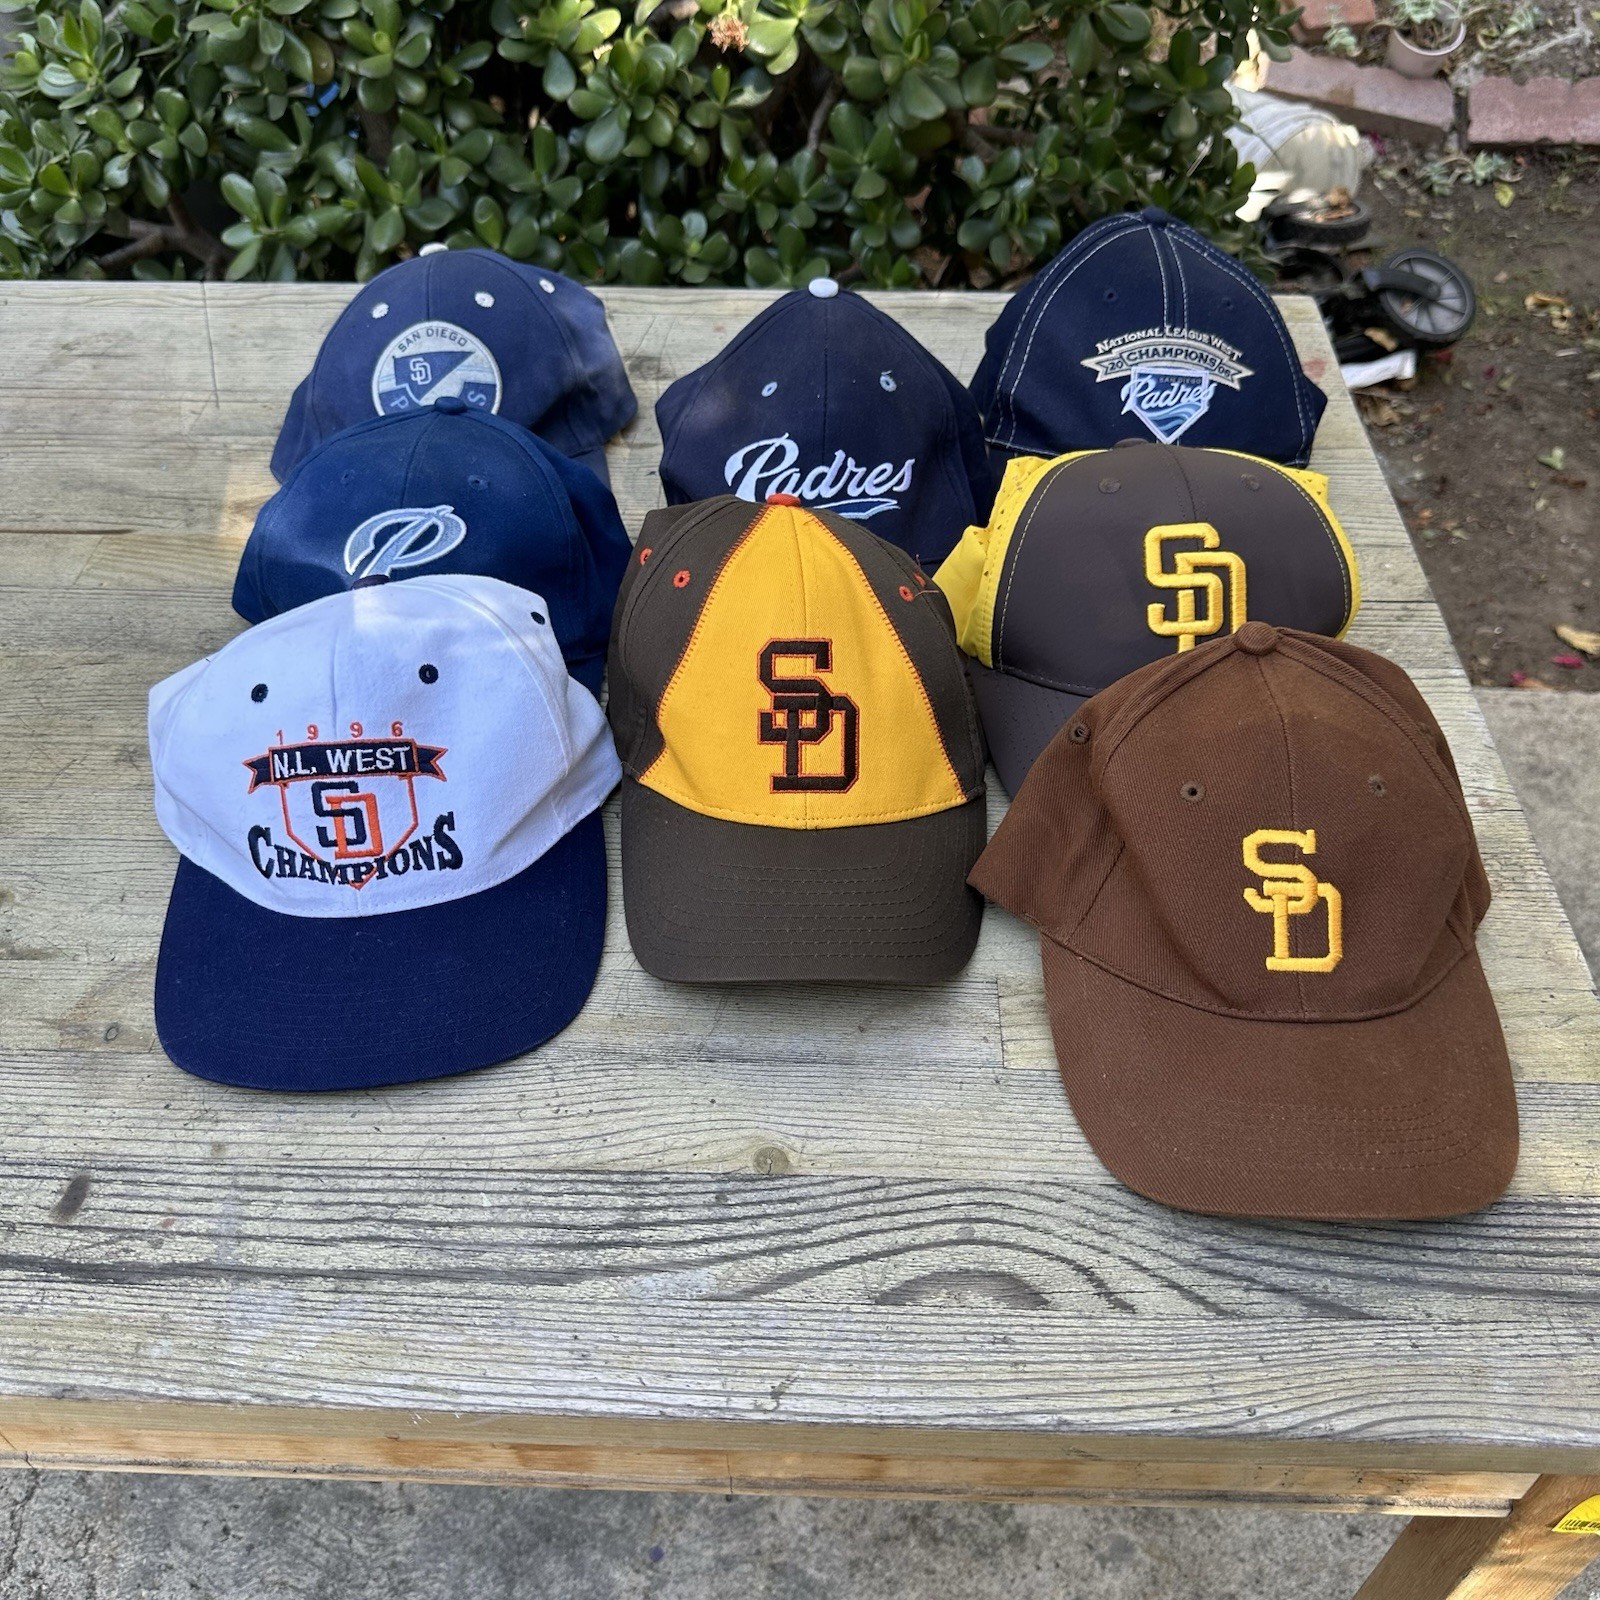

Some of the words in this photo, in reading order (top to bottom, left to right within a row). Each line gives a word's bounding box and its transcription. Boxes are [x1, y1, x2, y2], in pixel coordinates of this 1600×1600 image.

[398, 331, 421, 353] SAN
[426, 328, 468, 347] DIEGO
[1095, 326, 1164, 355] NATIONAL
[1164, 324, 1209, 343] LEAGUE
[1208, 334, 1244, 361] WEST
[1108, 360, 1123, 371] 20
[1126, 347, 1218, 367] CHAMPIONS
[409, 357, 432, 385] SD
[1120, 374, 1218, 416] Padres
[724, 432, 916, 503] Padres
[1144, 522, 1247, 653] SD
[757, 637, 860, 794] SD
[273, 751, 317, 779] N.L.
[325, 746, 411, 773] WEST
[311, 780, 384, 860] SD
[247, 811, 464, 886] CHAMPIONS
[1242, 829, 1343, 973] SD
